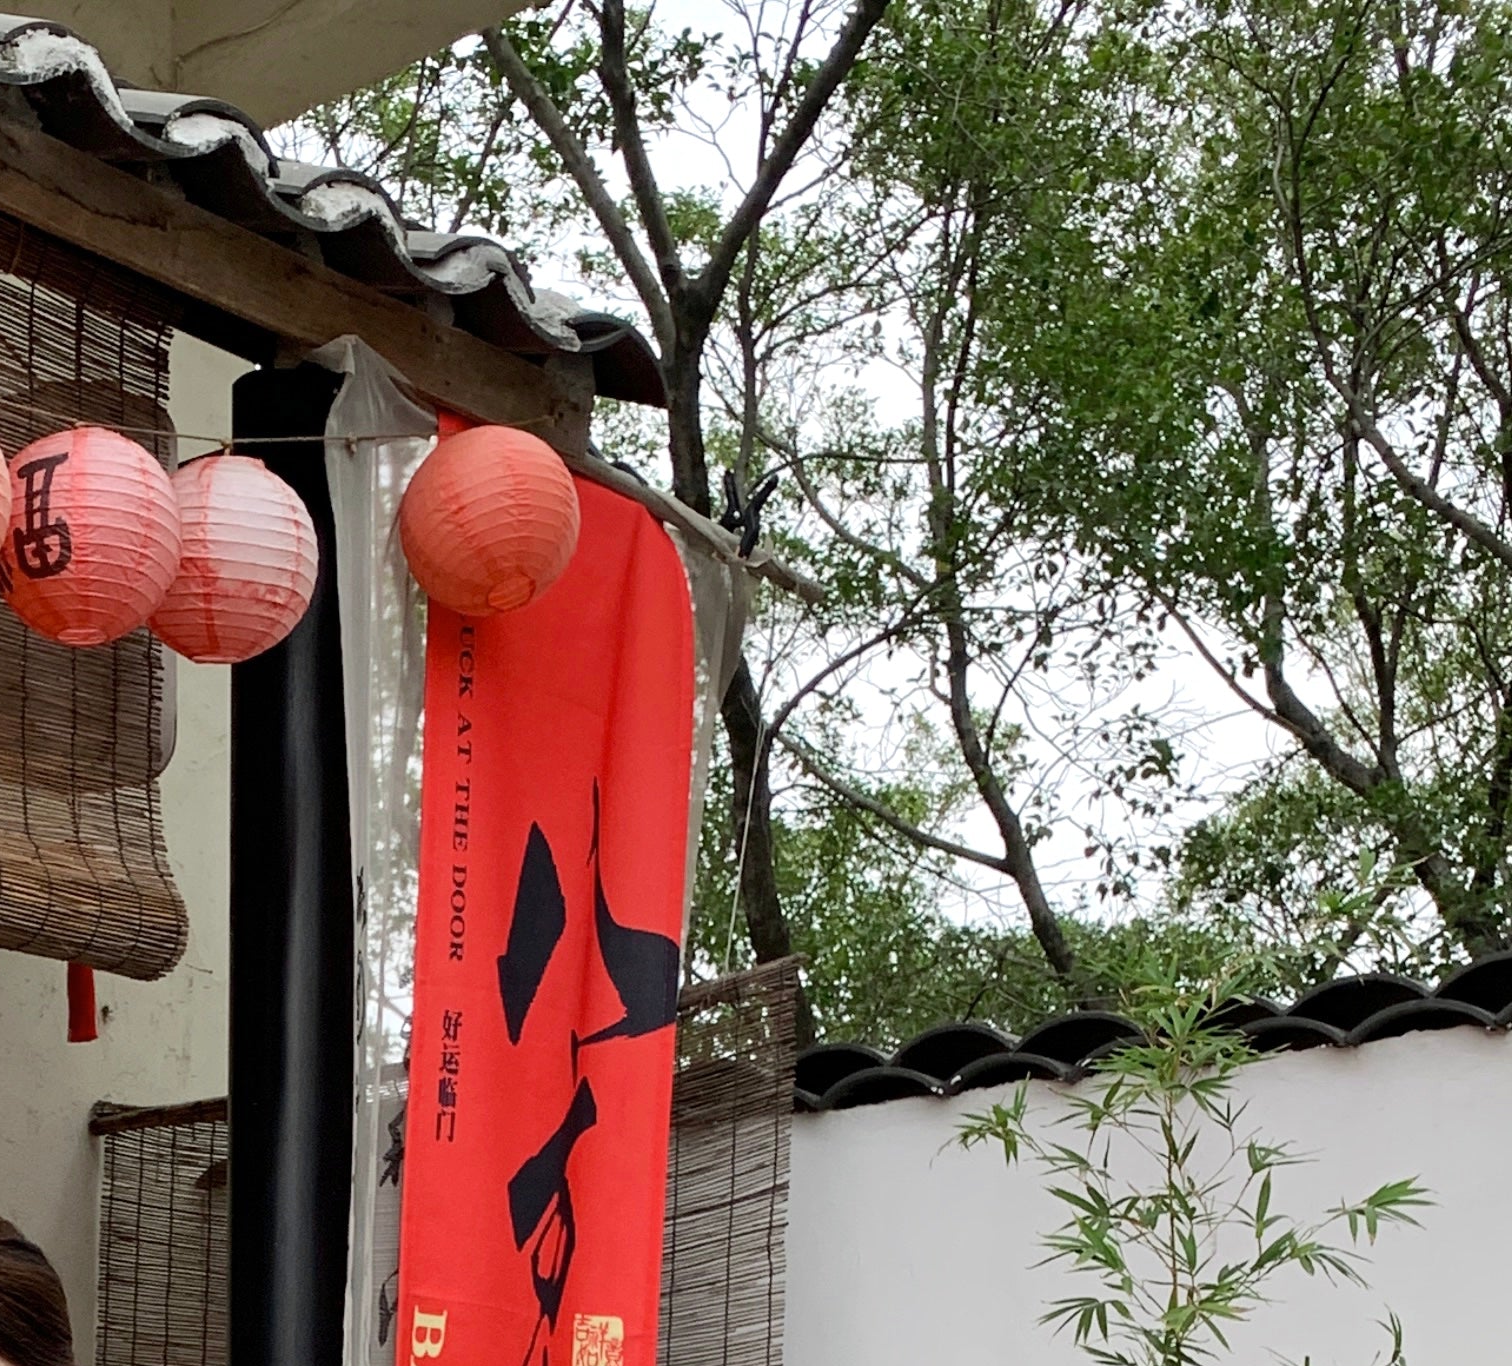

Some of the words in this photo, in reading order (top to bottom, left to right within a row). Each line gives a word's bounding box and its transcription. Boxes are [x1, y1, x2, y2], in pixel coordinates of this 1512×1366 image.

[457, 612, 475, 698] UCK
[457, 712, 472, 764] AT
[453, 778, 470, 851] THE
[448, 865, 467, 961] DOOR
[436, 1009, 463, 1142] 好运临门
